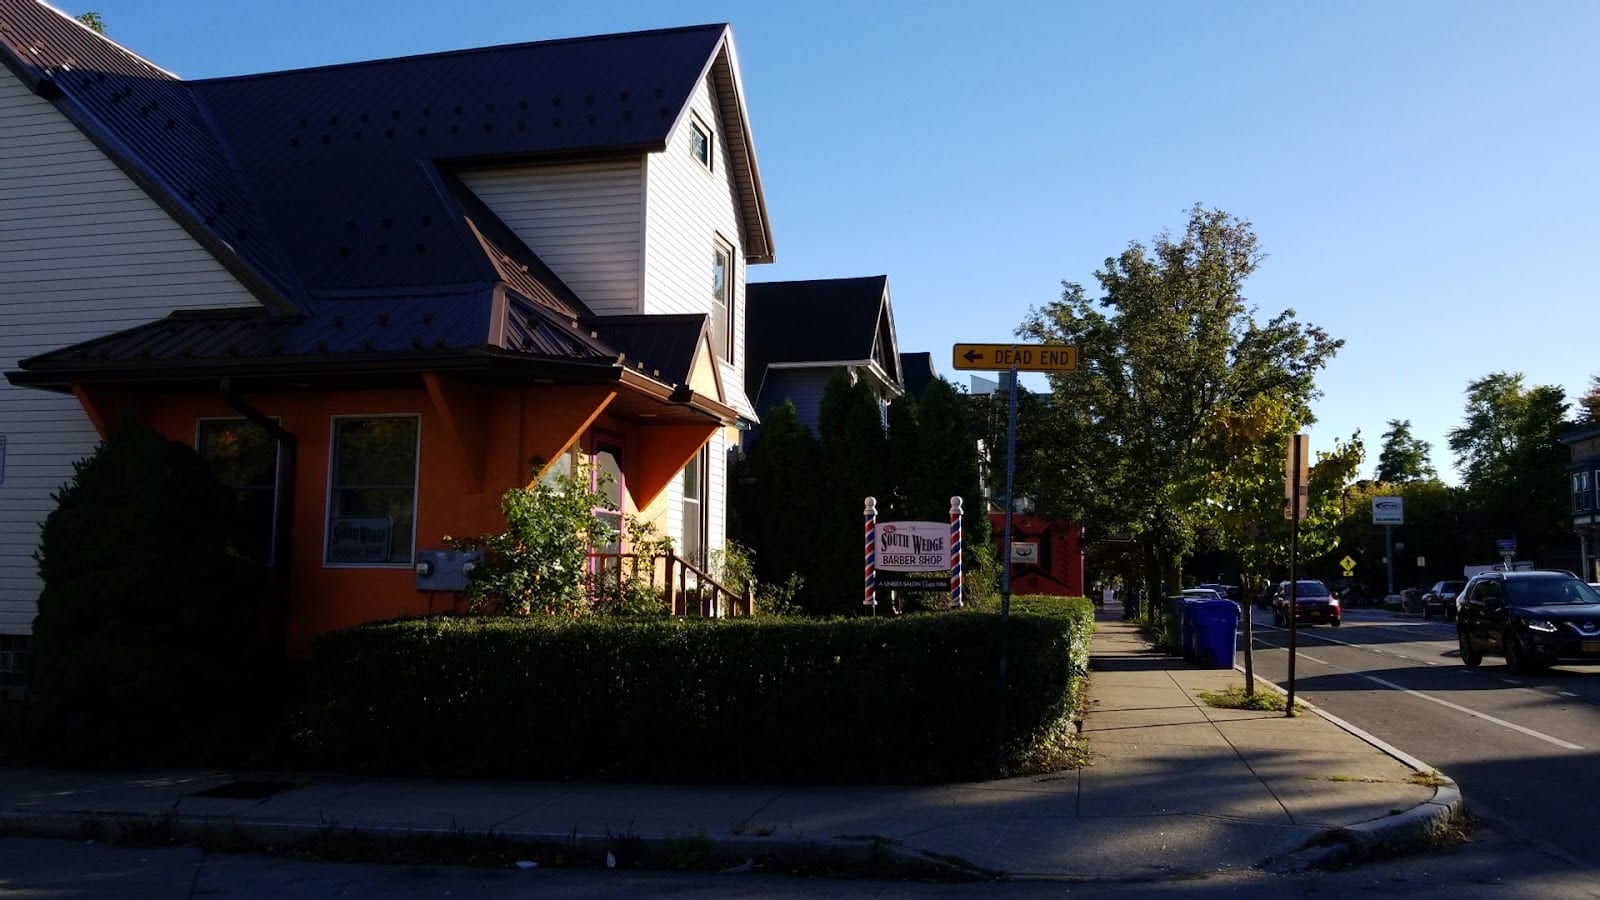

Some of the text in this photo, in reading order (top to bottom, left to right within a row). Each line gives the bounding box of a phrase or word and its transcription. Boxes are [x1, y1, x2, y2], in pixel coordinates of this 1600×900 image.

[995, 350, 1069, 365] DEAD END
[881, 533, 944, 555] SOUTH WEDGE
[883, 555, 943, 565] BARBER SHOP
